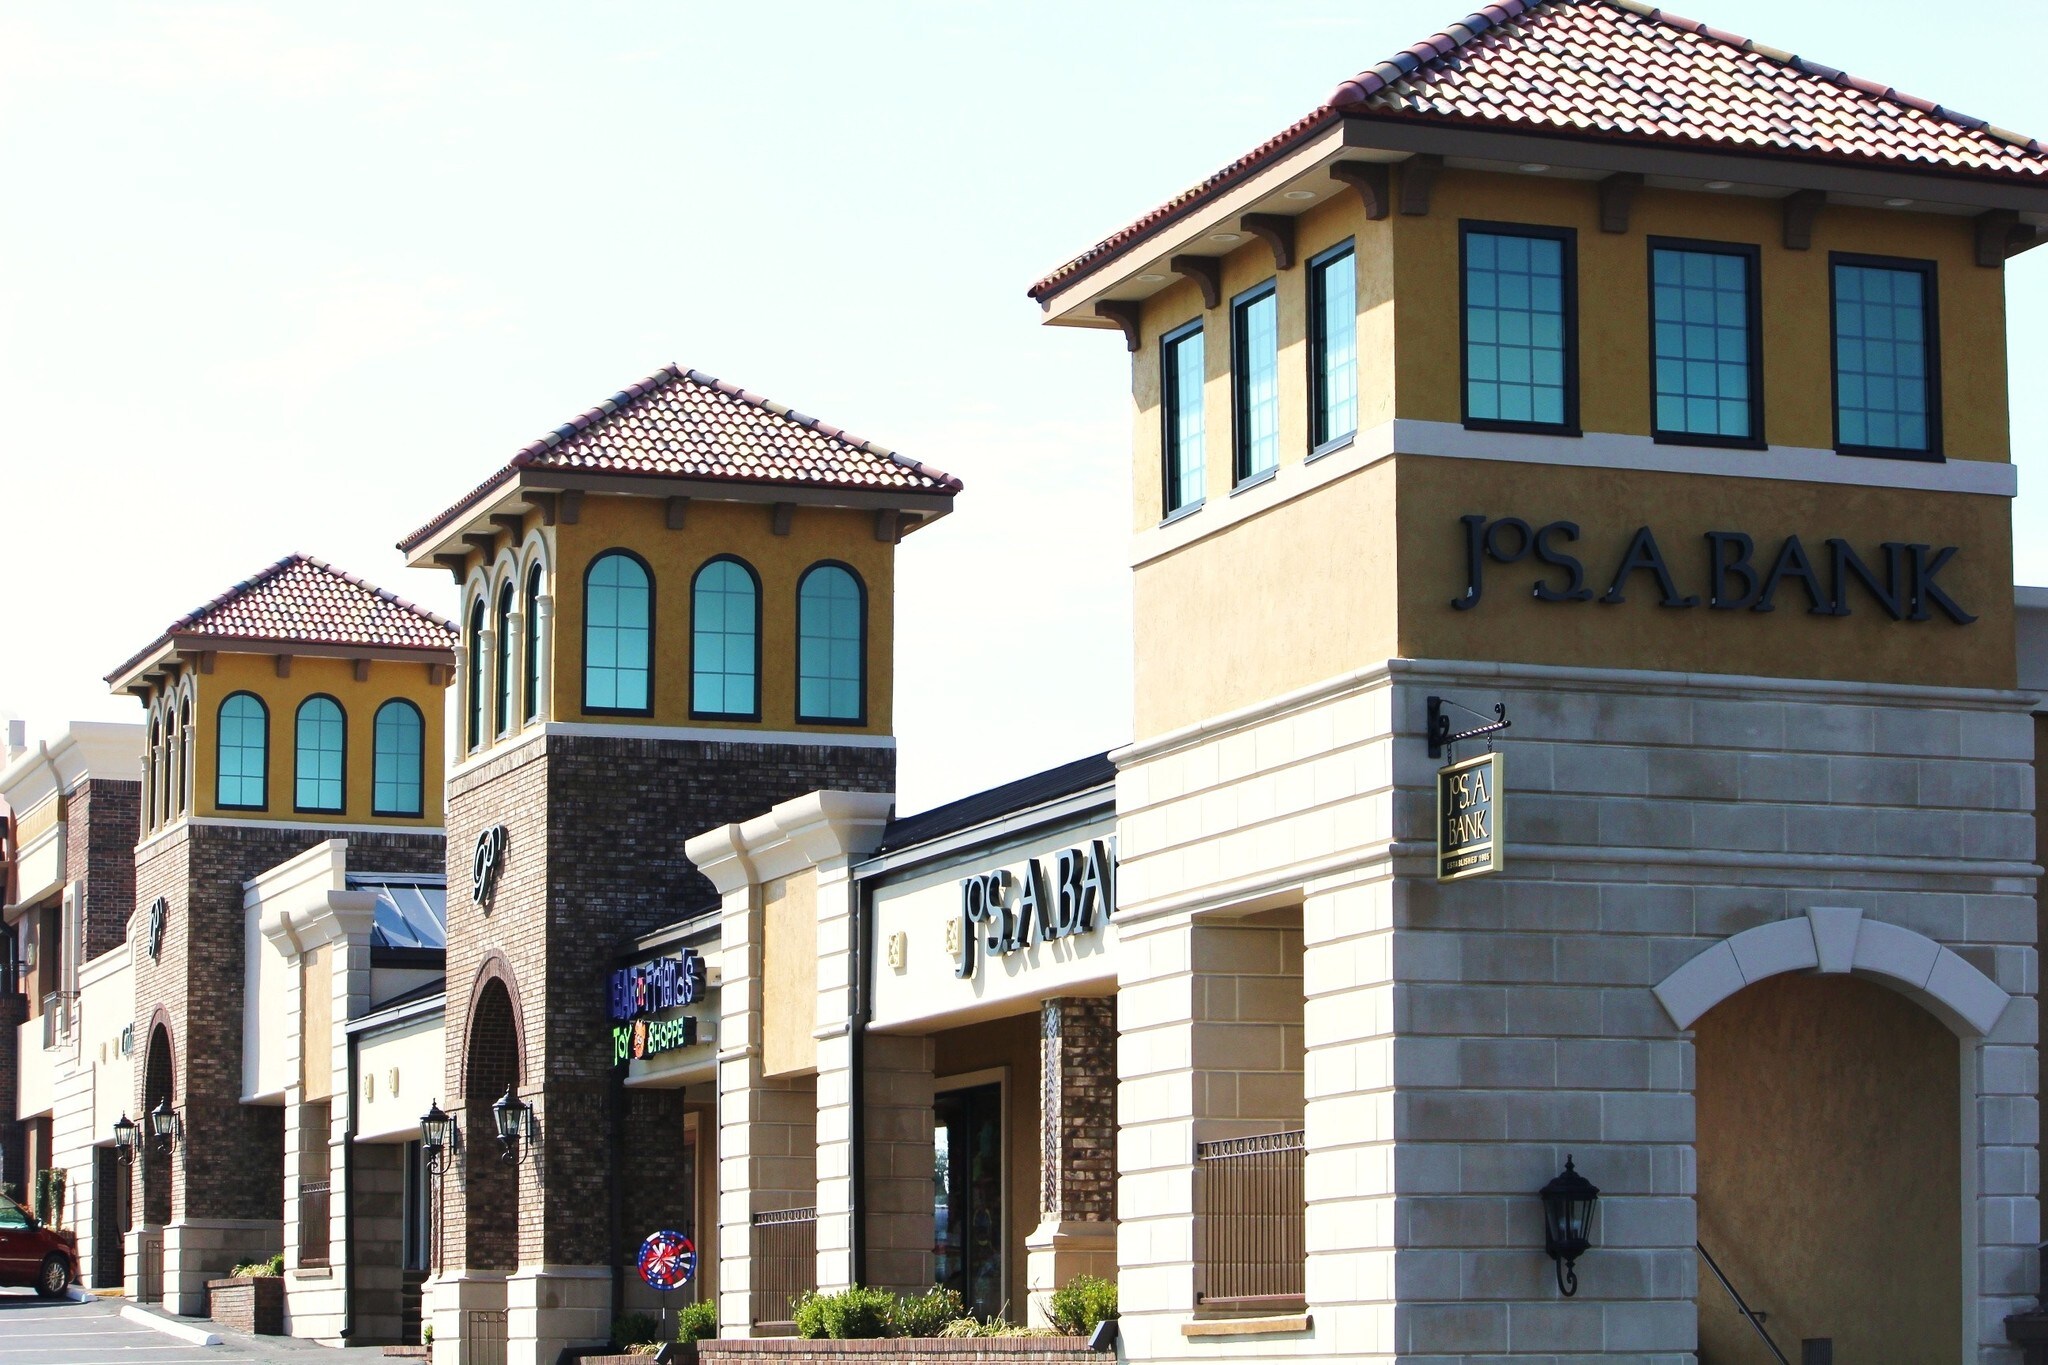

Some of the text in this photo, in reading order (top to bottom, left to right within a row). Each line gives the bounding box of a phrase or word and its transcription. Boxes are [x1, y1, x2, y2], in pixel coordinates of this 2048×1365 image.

[1703, 531, 1979, 626] BANK
[1449, 810, 1489, 845] BANK
[612, 1016, 685, 1067] TOY SHOPPE
